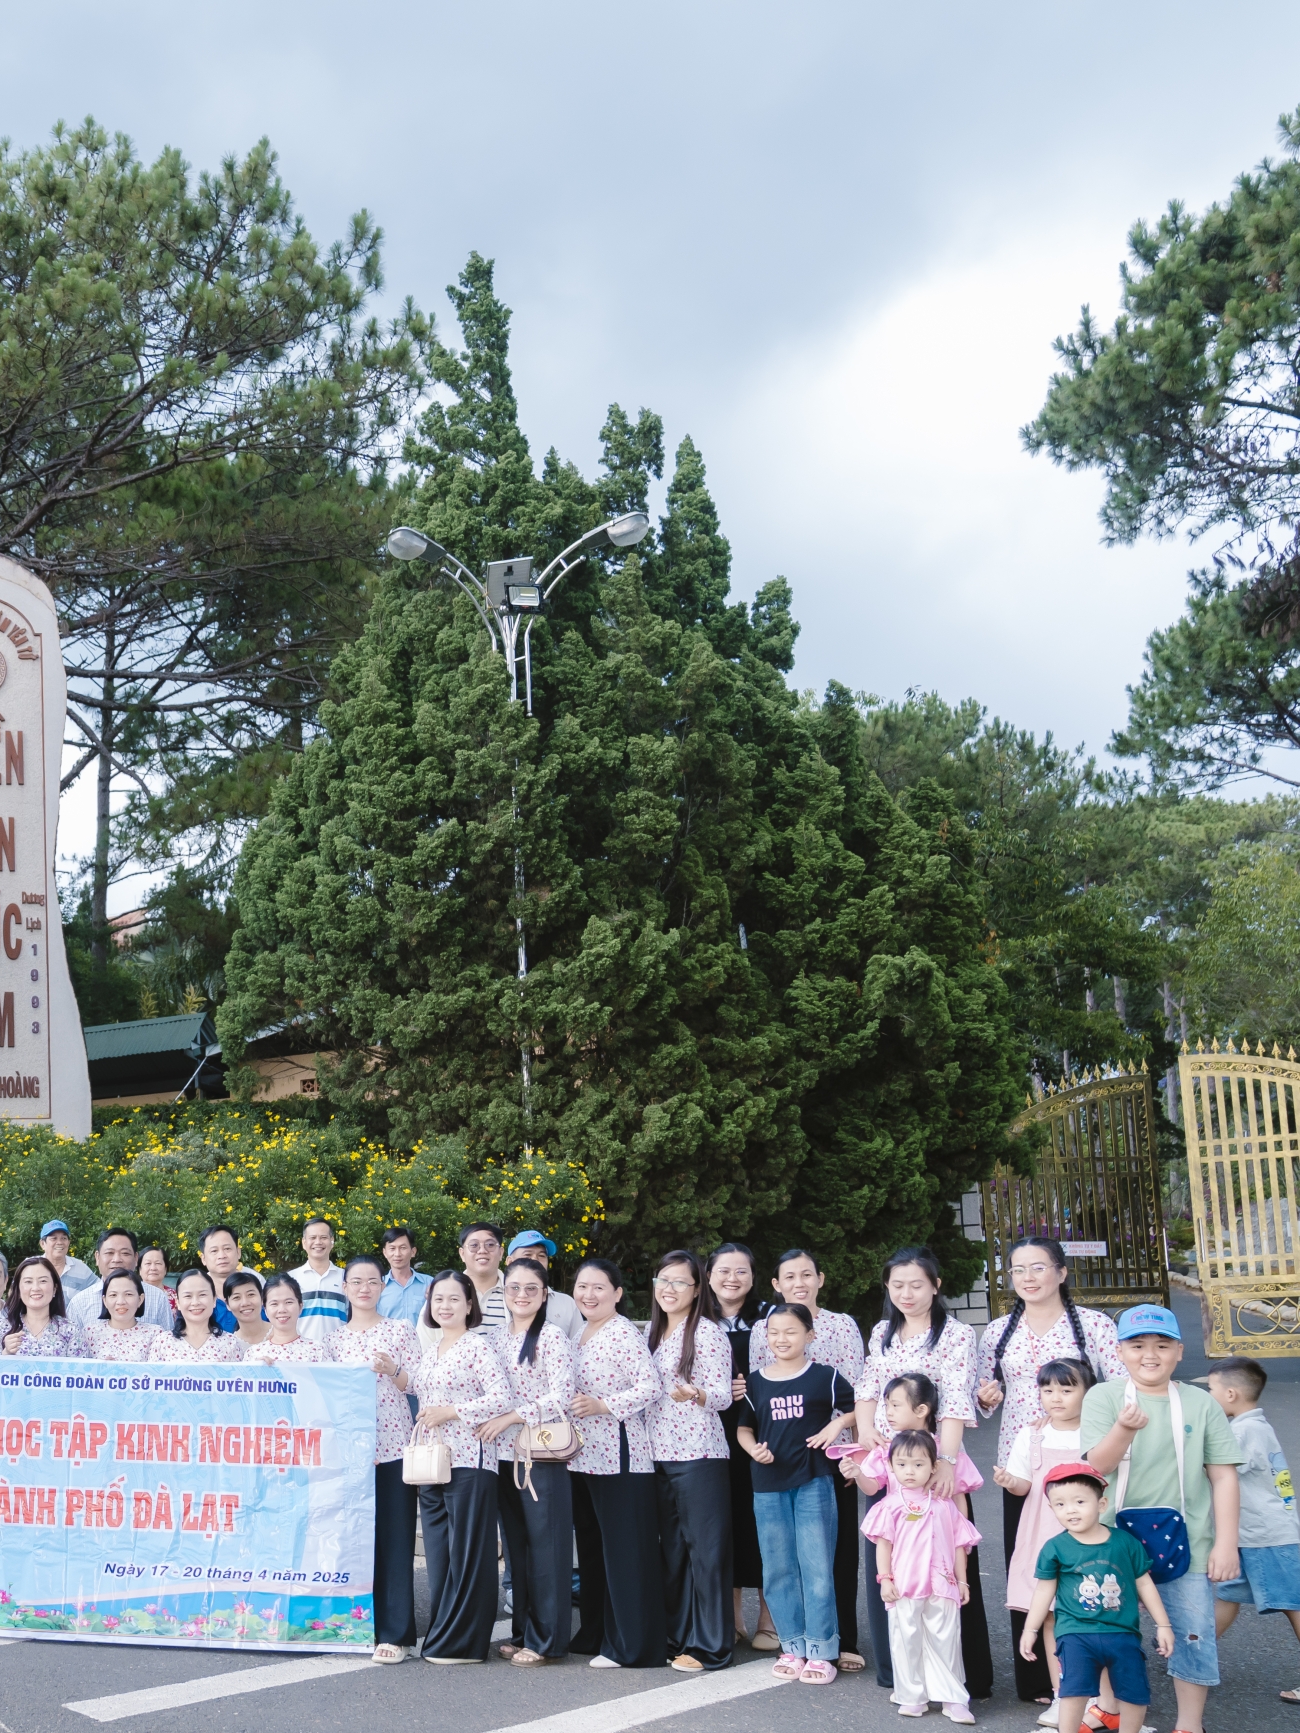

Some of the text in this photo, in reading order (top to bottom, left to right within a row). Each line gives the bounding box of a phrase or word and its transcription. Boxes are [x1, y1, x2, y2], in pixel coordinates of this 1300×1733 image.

[7, 624, 28, 648] YÊN
[21, 891, 45, 906] Dương
[26, 917, 41, 932] Lịch
[23, 1372, 62, 1388] CÔNG
[65, 1375, 104, 1390] ĐOÀN
[108, 1376, 127, 1390] CƠ
[131, 1374, 150, 1390] SỞ
[154, 1377, 212, 1392] PHƯỜNG
[216, 1377, 251, 1393] UYÊN
[258, 1380, 297, 1394] HƯNG
[50, 1414, 108, 1466] TẬP
[115, 1423, 190, 1463] KINH
[200, 1419, 322, 1473] NGHIỆM
[64, 1476, 125, 1528] PHỐ
[132, 1484, 173, 1530] ĐÀ
[181, 1493, 240, 1539] LẠT
[104, 1563, 145, 1578] Ngày
[151, 1565, 169, 1576] 17
[183, 1566, 203, 1578] 20
[207, 1567, 253, 1582] tháng
[257, 1569, 267, 1581] 4
[272, 1570, 307, 1582] năm
[311, 1571, 350, 1584] 2025
